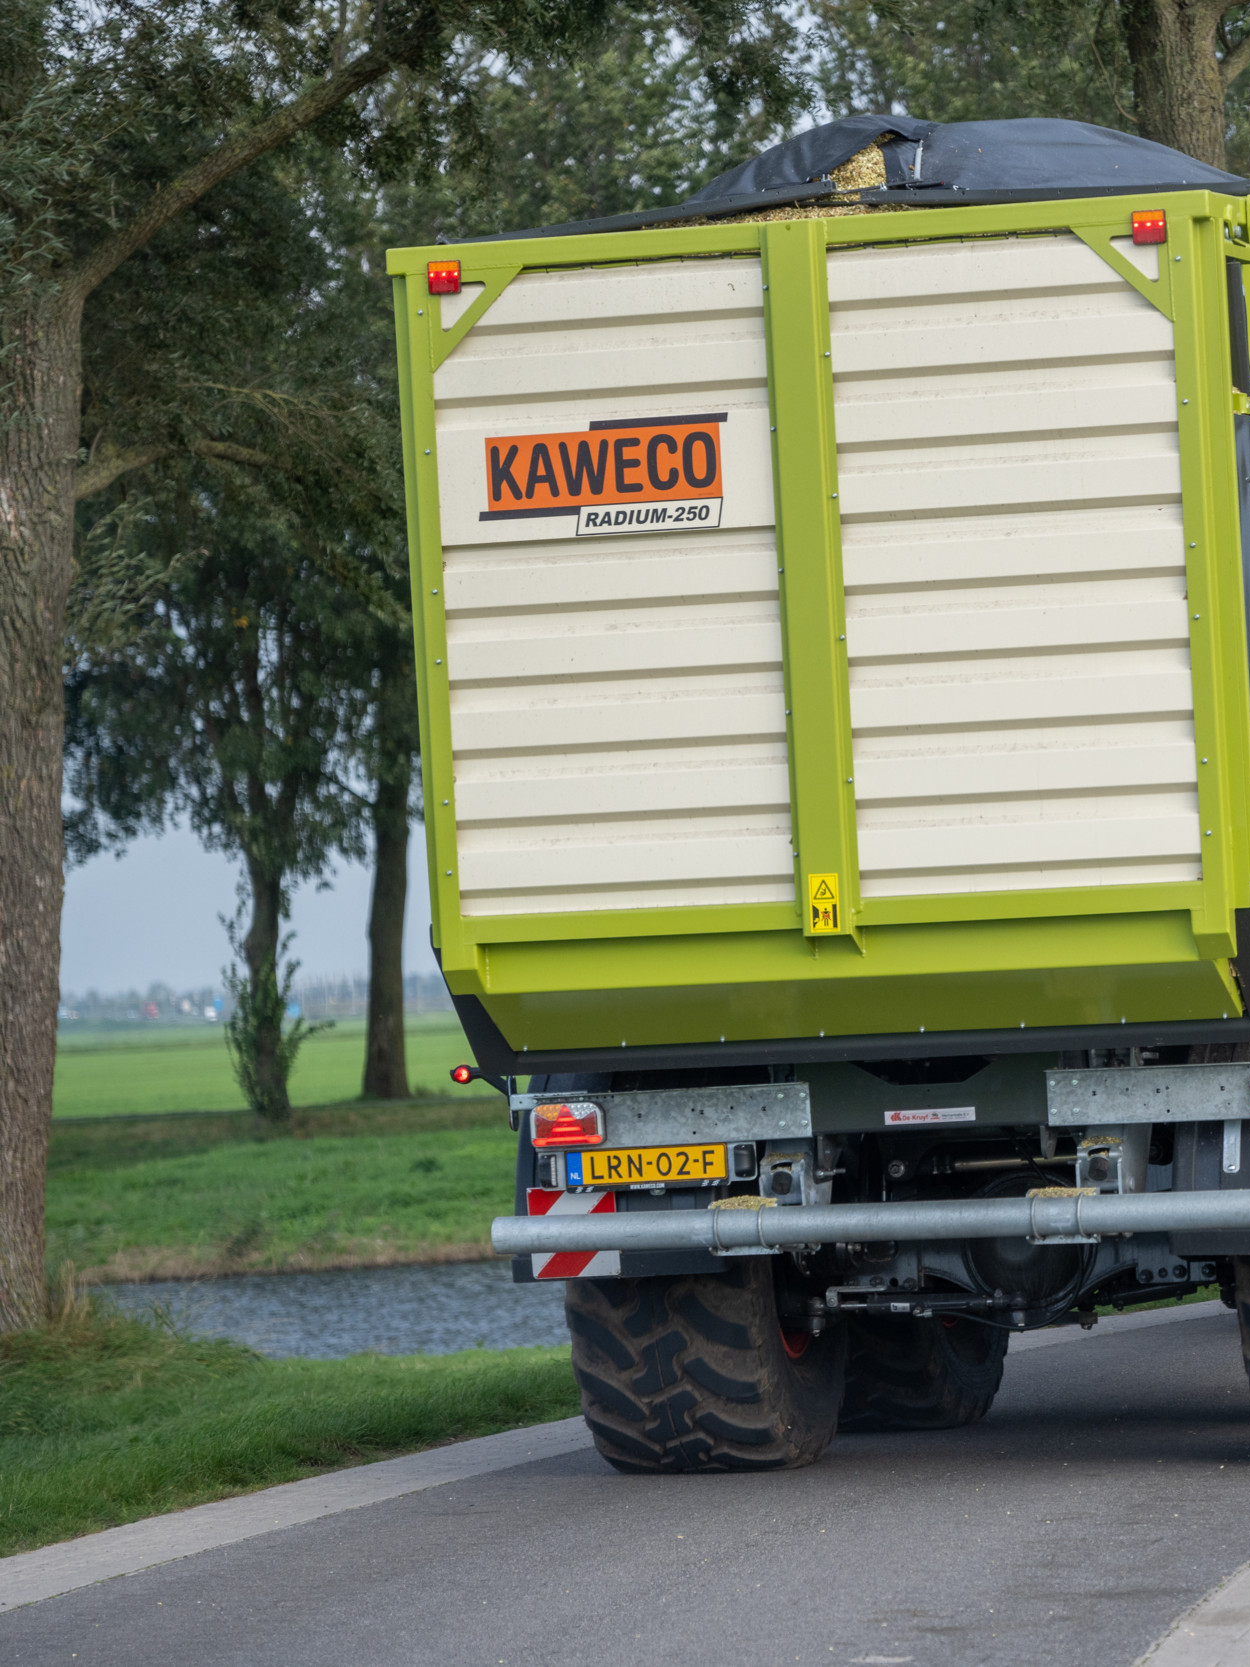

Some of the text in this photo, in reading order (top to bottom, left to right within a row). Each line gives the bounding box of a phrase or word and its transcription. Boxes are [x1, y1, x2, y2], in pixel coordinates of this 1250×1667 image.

[490, 431, 717, 502] KAWECO
[585, 505, 710, 527] RADIUM-250
[570, 1172, 582, 1180] NL
[590, 1150, 715, 1180] LRN-02-F
